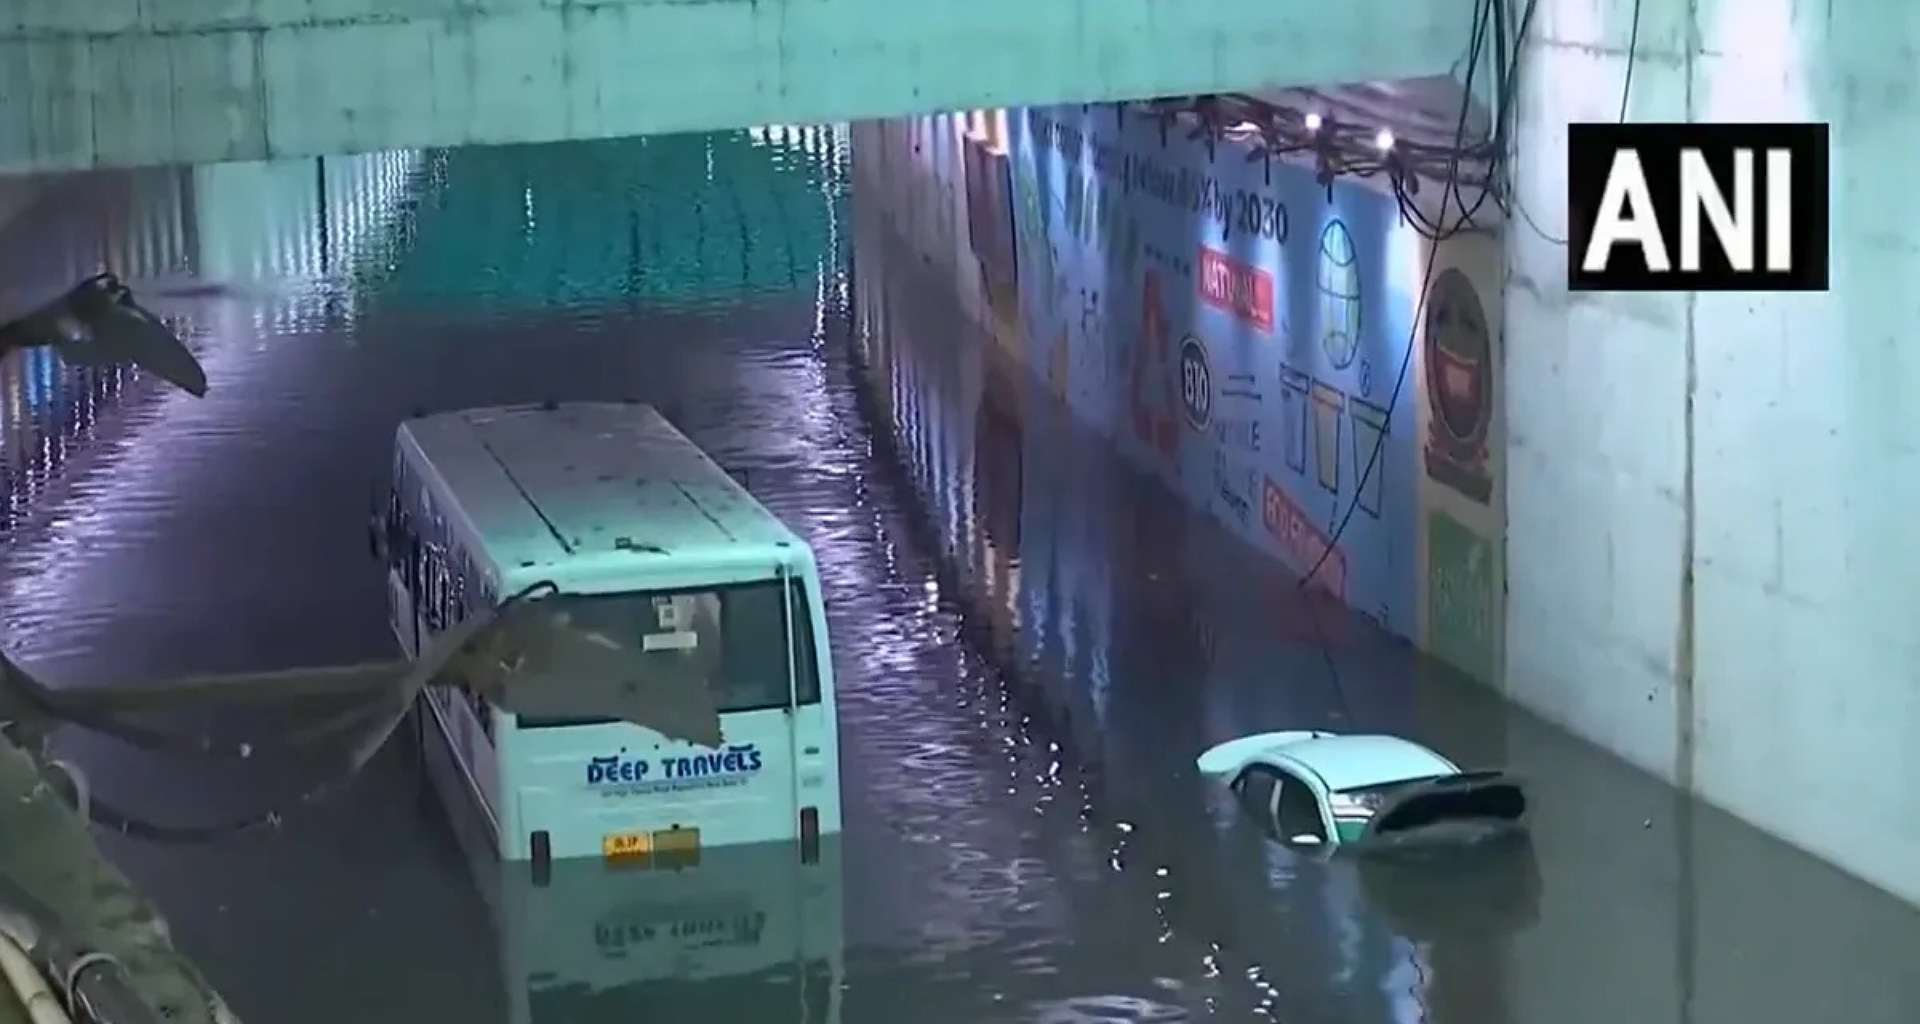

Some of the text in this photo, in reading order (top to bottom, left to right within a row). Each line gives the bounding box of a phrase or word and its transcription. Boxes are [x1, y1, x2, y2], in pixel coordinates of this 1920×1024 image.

[1236, 189, 1288, 244] 2030
[1184, 356, 1209, 414] BIO
[587, 745, 762, 784] DEEP TRAVELS
